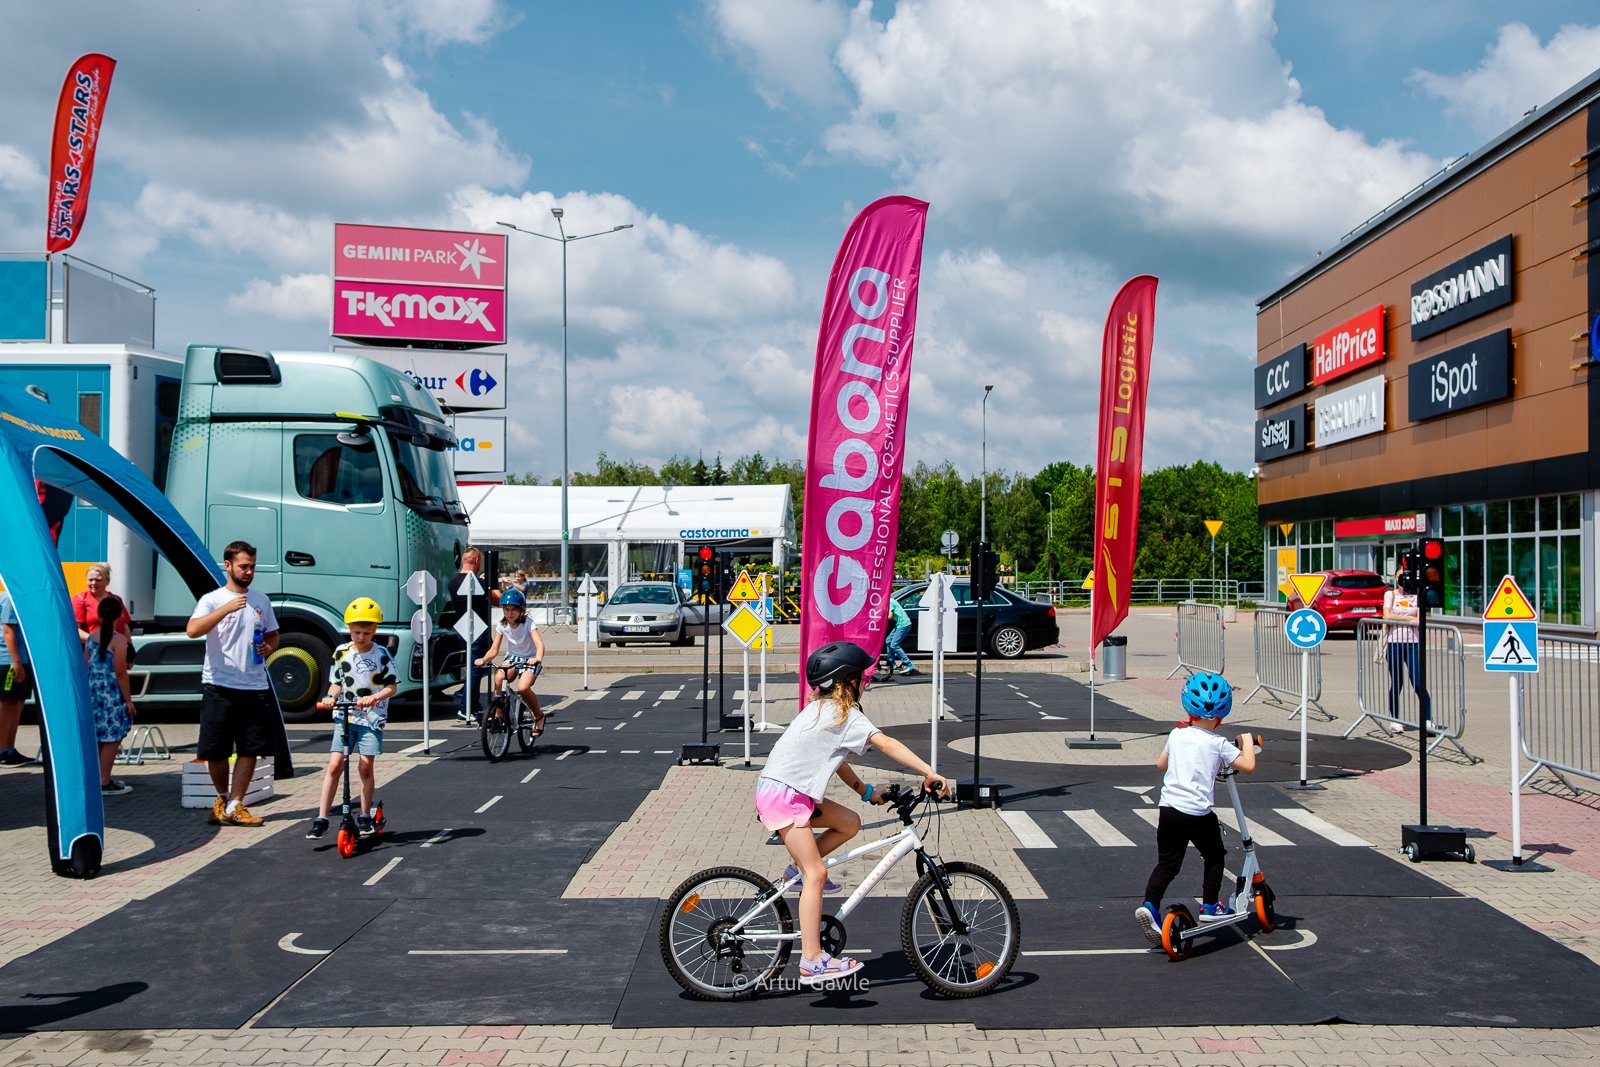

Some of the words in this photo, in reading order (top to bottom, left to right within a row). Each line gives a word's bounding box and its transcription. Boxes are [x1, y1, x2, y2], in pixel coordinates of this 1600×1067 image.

[343, 244, 411, 262] GEMINI
[413, 248, 458, 265] PARK
[1411, 254, 1505, 326] ROSSMANN
[887, 277, 907, 366] SUPPLIER
[1114, 311, 1138, 414] Logistic
[1266, 360, 1290, 396] CCC
[1316, 327, 1377, 378] HalfPrice
[1431, 353, 1478, 409] iSpot
[813, 266, 891, 627] Gabona
[882, 371, 900, 480] COSMETICS
[1261, 420, 1290, 450] sinsay
[680, 527, 750, 539] castorama
[1385, 519, 1401, 531] MAXI
[1402, 517, 1416, 530] ZOO
[868, 487, 893, 632] PROFESSIONAL
